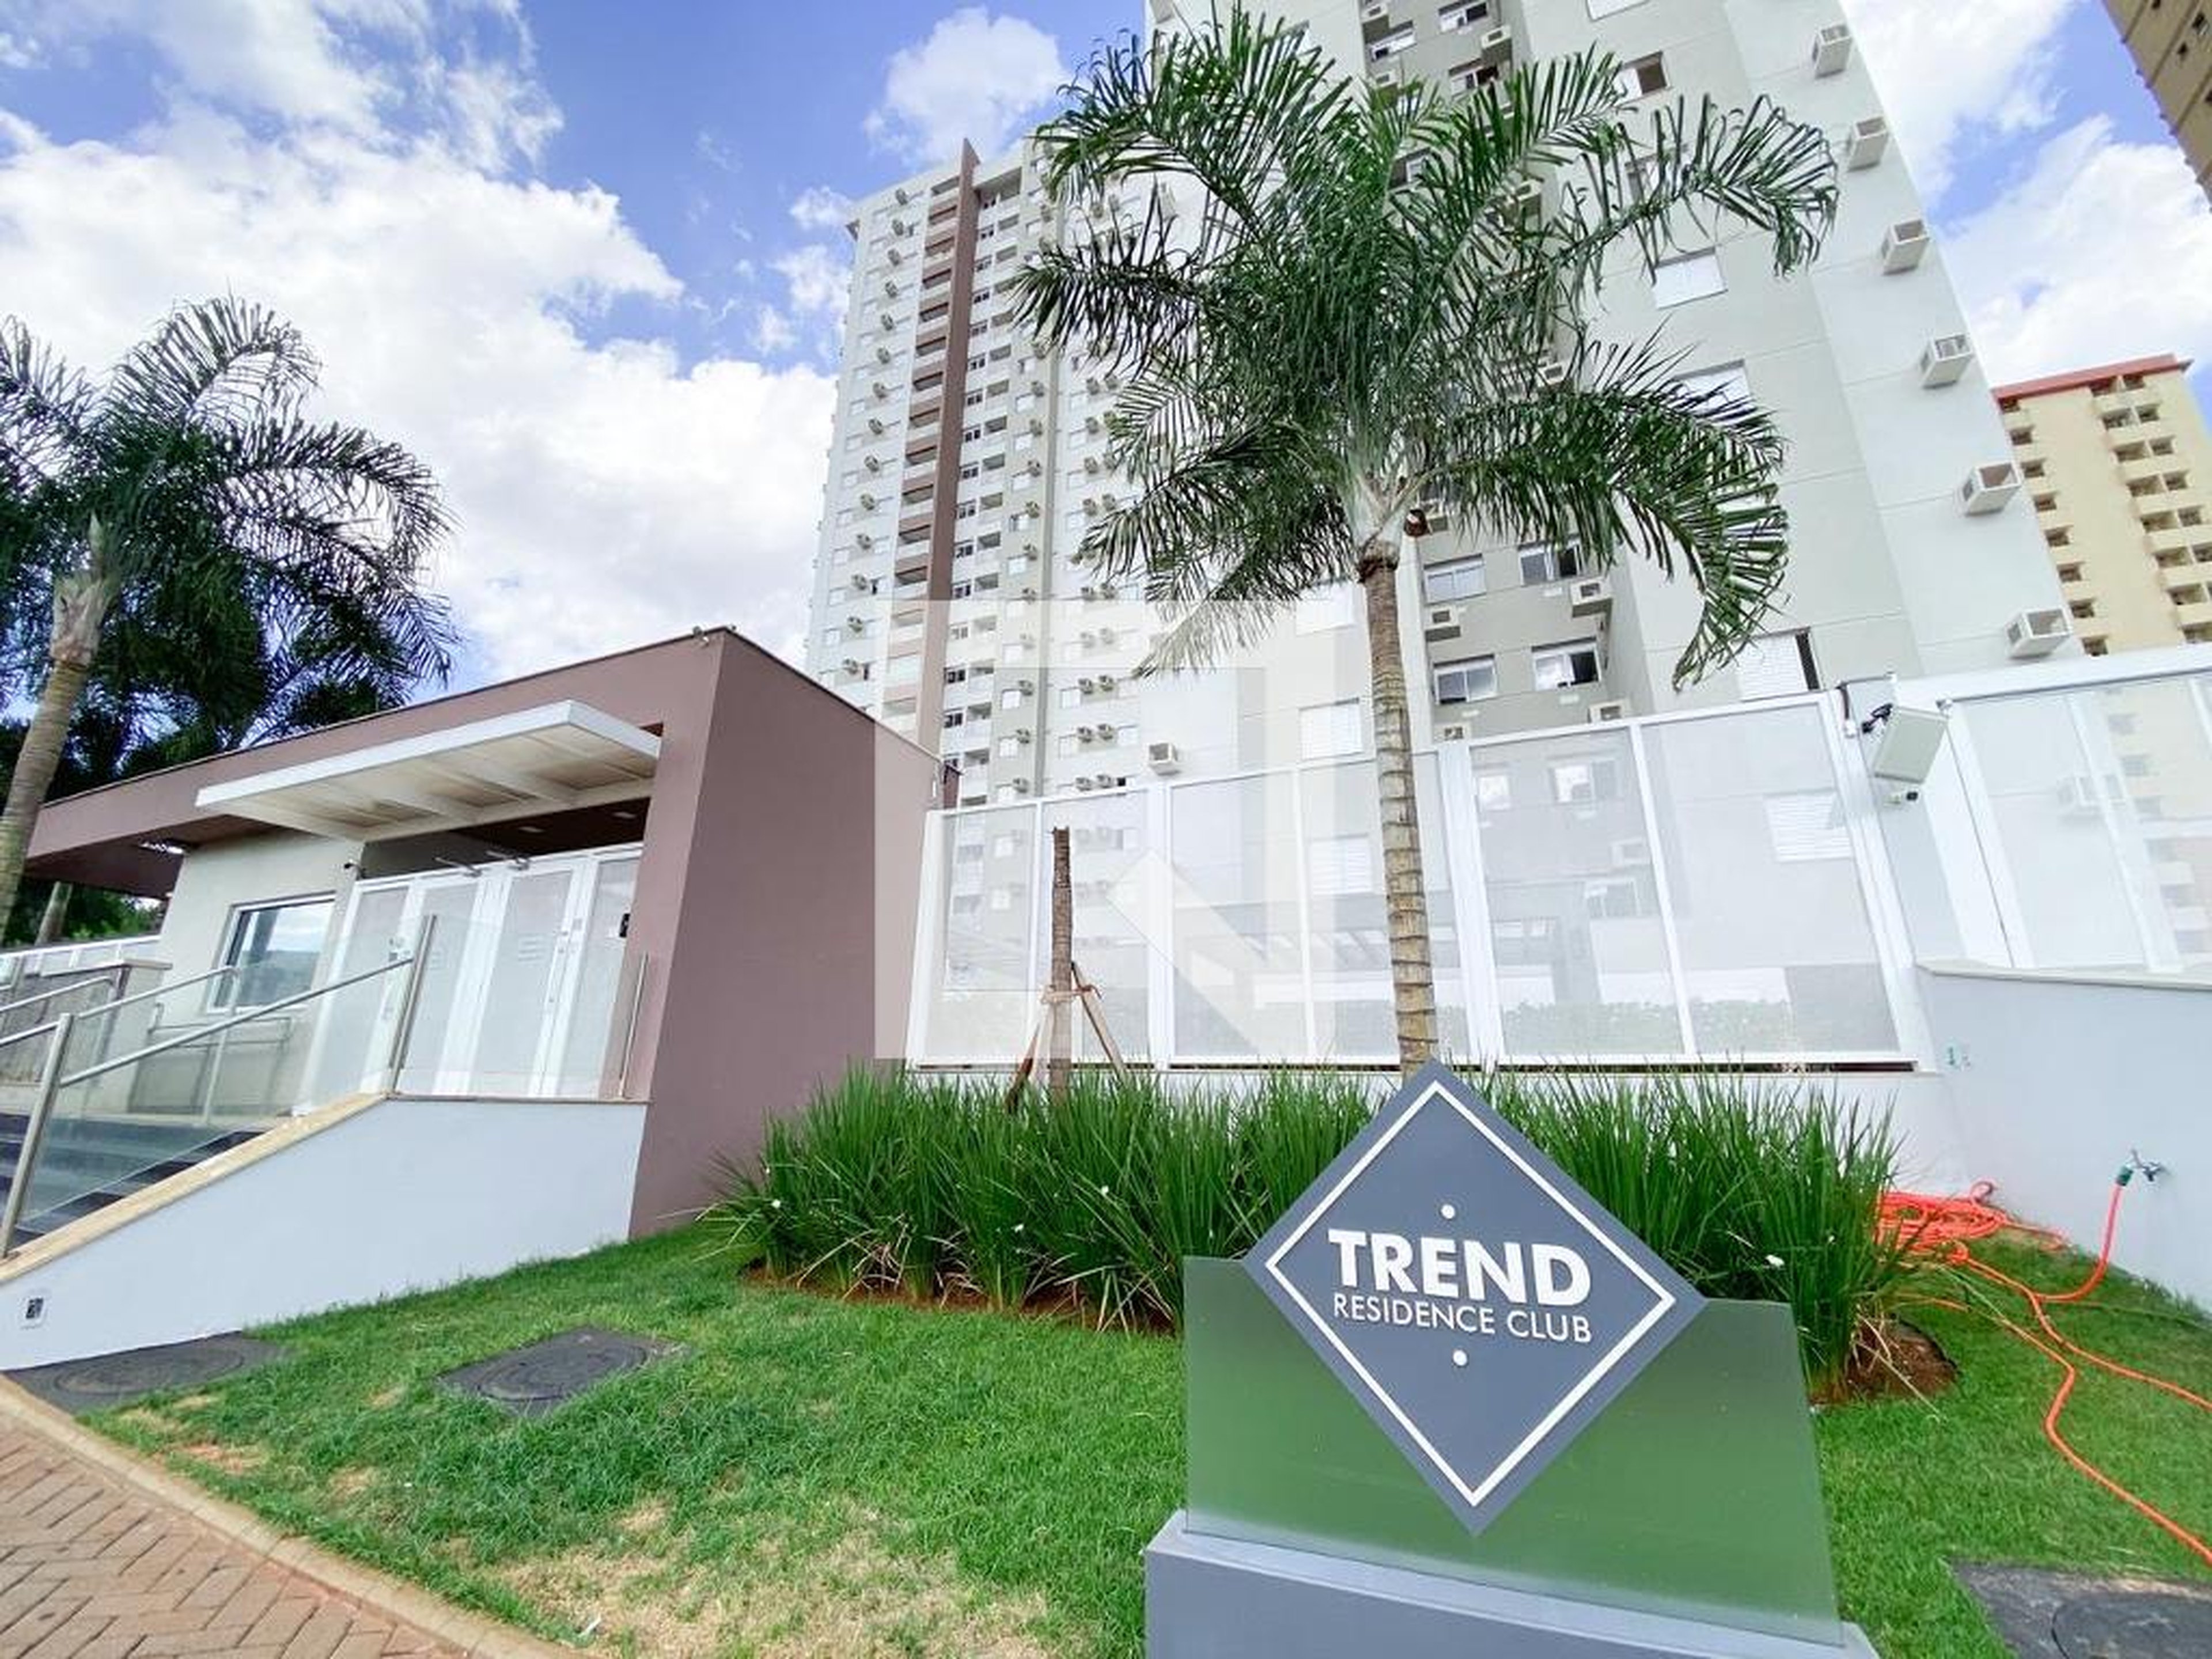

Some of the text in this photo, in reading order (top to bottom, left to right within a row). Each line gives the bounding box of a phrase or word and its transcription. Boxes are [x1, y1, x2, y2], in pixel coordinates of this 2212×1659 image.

[1327, 1228, 1591, 1306] TREND
[1333, 1292, 1592, 1343] RESIDENCE CLUB
